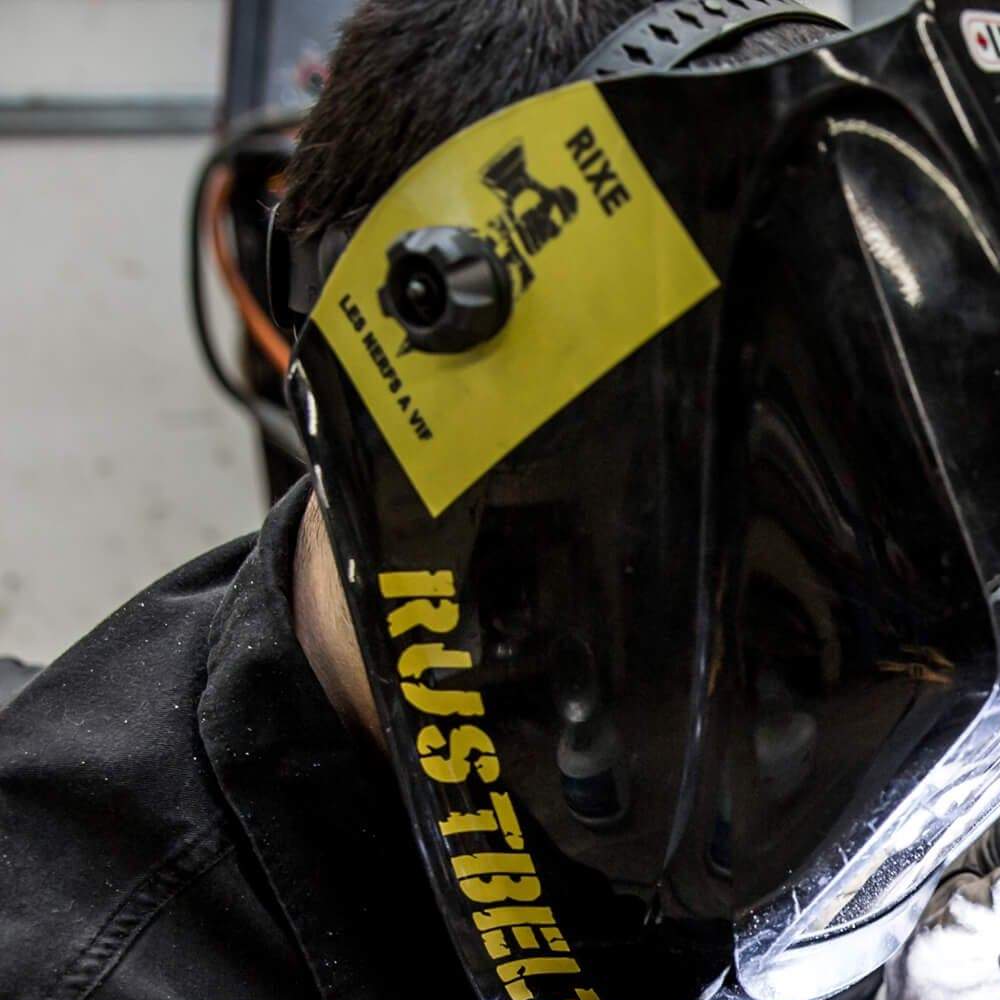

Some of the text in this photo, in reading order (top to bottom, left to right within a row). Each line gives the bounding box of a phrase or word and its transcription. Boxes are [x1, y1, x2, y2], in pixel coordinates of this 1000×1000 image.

[565, 125, 631, 218] RIXE
[339, 294, 366, 332] LES
[362, 331, 403, 394] NERFS
[409, 408, 433, 441] VIF
